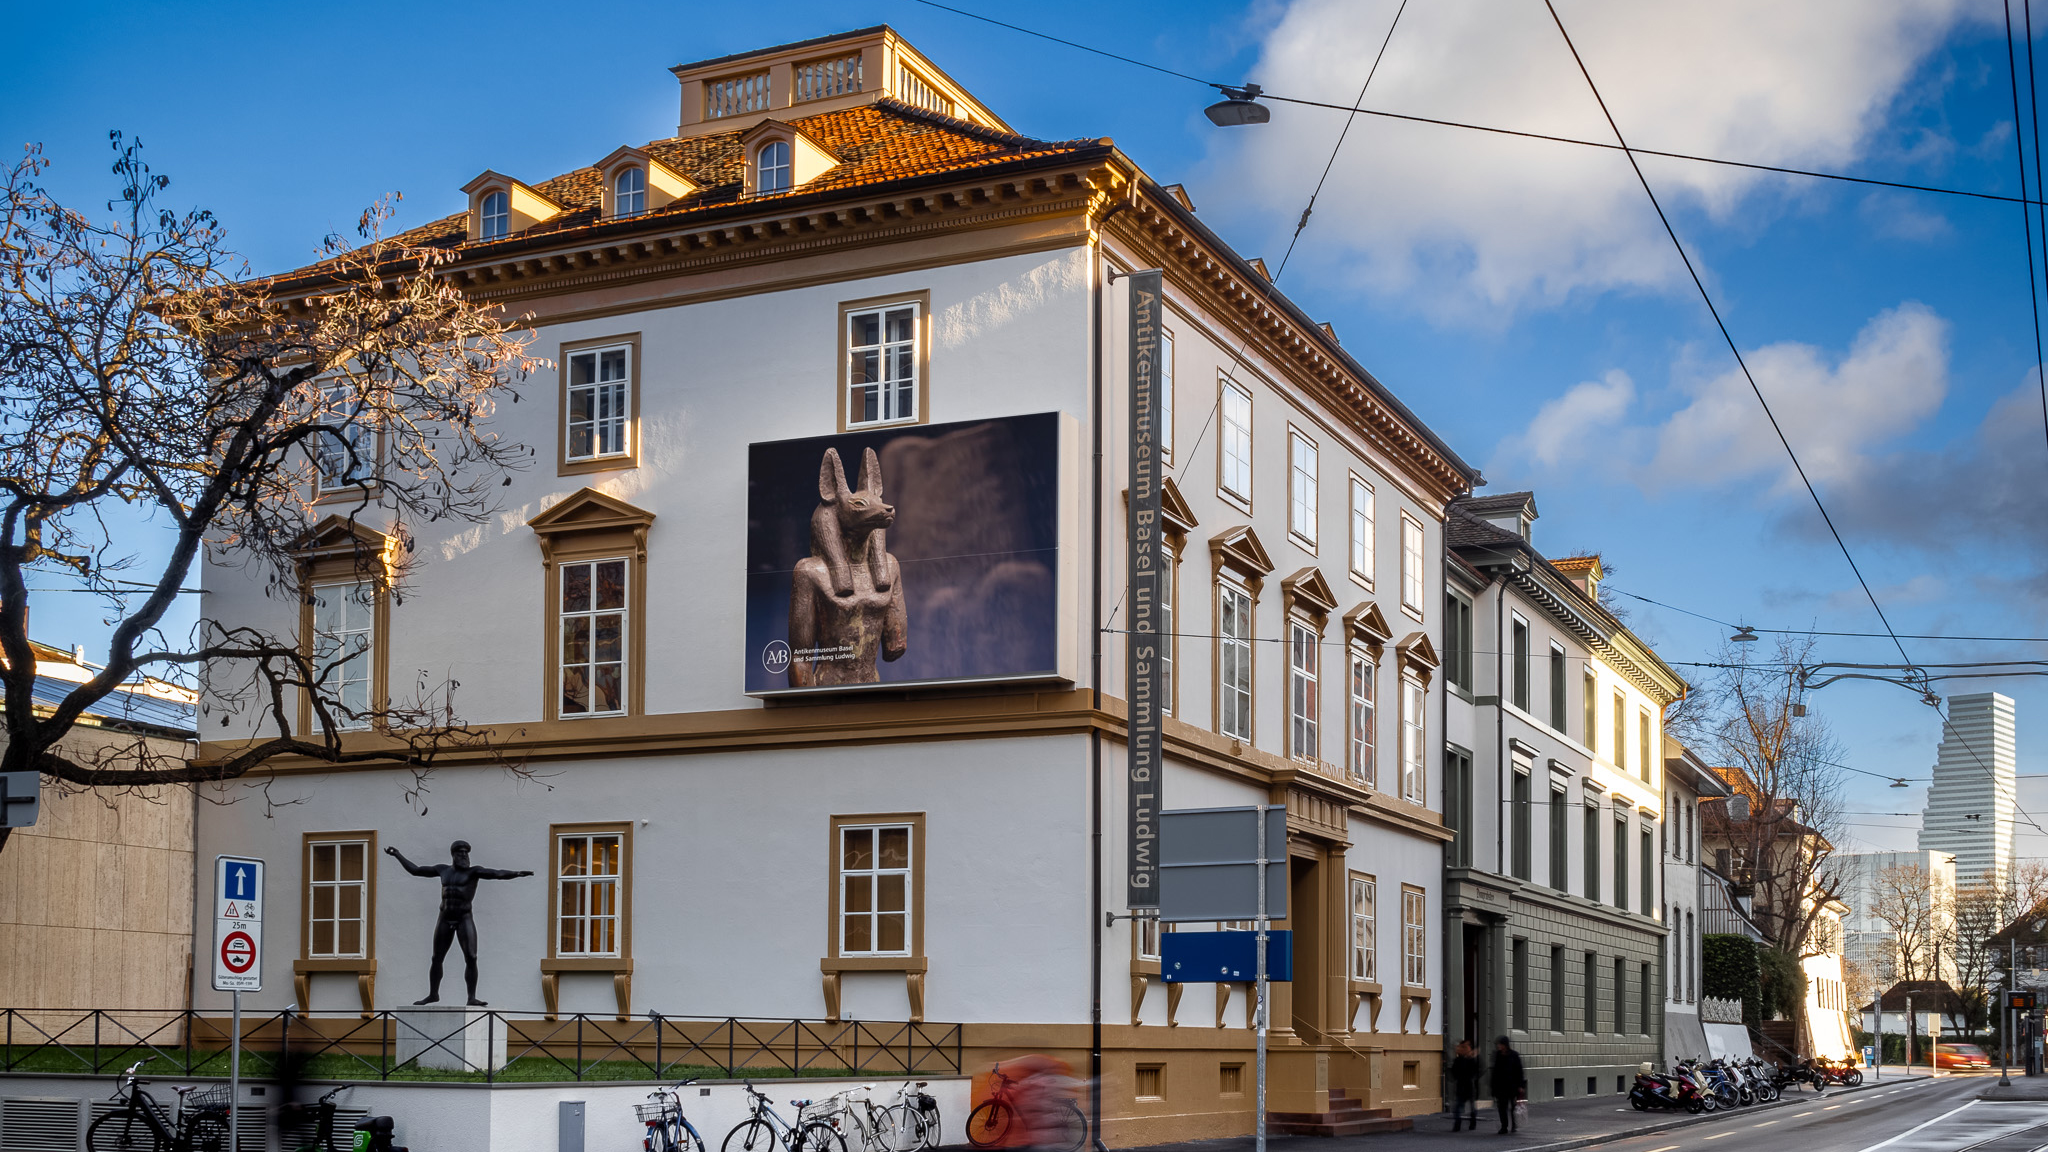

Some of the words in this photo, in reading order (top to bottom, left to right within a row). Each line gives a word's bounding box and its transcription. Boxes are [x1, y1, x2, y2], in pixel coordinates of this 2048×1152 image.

[1136, 289, 1156, 500] Antikenmuseum
[1136, 509, 1156, 577] Basel
[1136, 587, 1156, 635] und
[793, 647, 838, 655] Antikenmuseum
[838, 644, 854, 652] Basel
[805, 654, 834, 662] Sammlung
[834, 652, 856, 660] Ludwig
[1130, 645, 1156, 782] Sammlung
[1130, 793, 1156, 889] Ludwig
[232, 921, 247, 930] 25m
